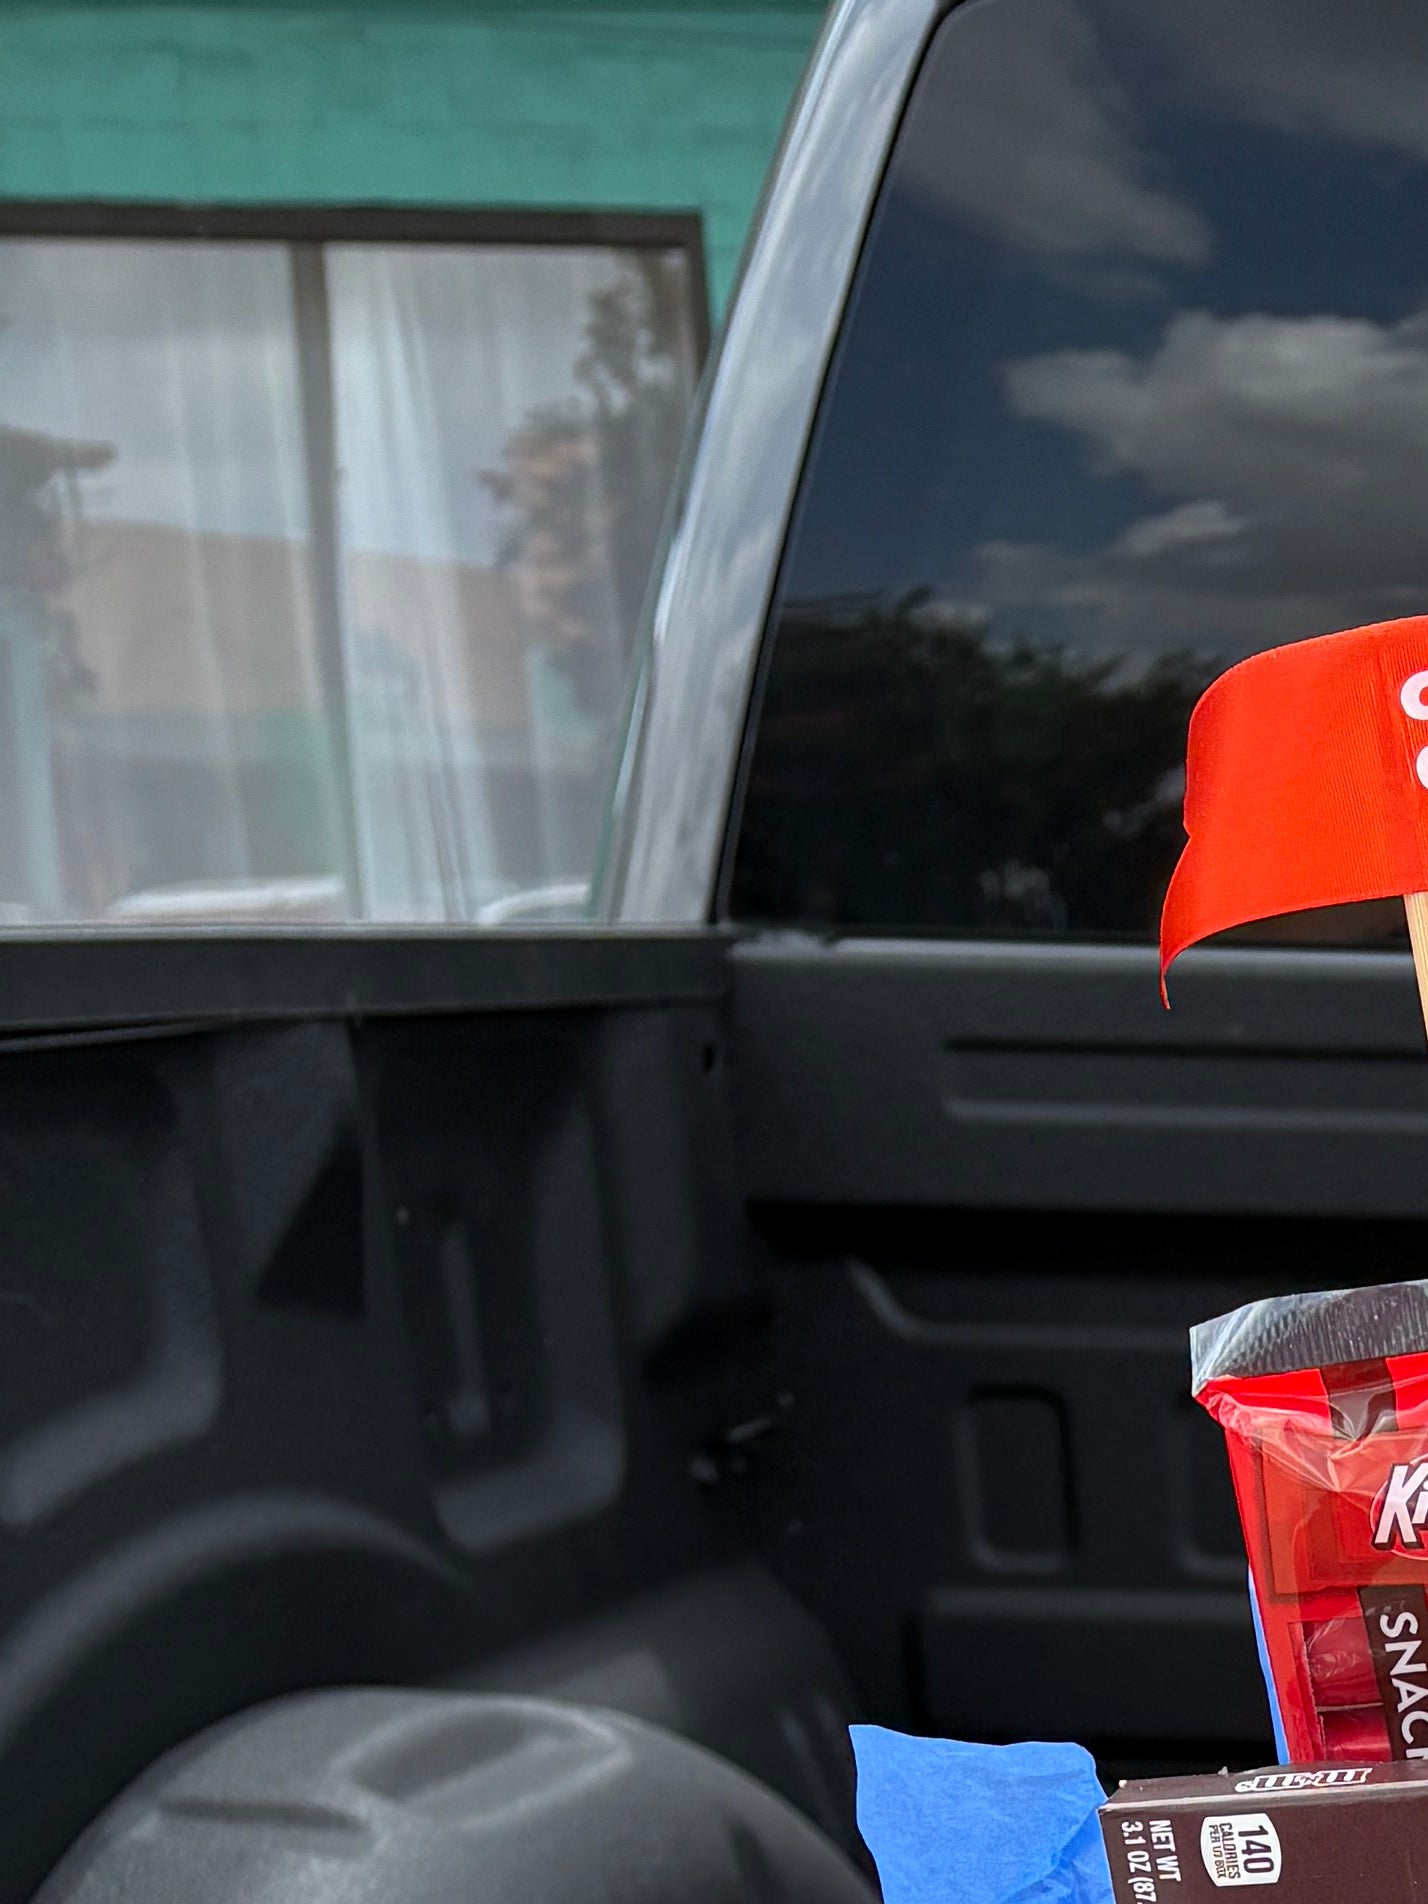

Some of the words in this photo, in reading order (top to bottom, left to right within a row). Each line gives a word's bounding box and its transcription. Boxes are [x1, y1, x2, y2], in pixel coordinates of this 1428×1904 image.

[1121, 1821, 1147, 1845] 3.1
[1149, 1820, 1176, 1851] NET
[1128, 1850, 1152, 1874] OZ
[1237, 1825, 1275, 1873] 140
[1156, 1855, 1182, 1883] WT
